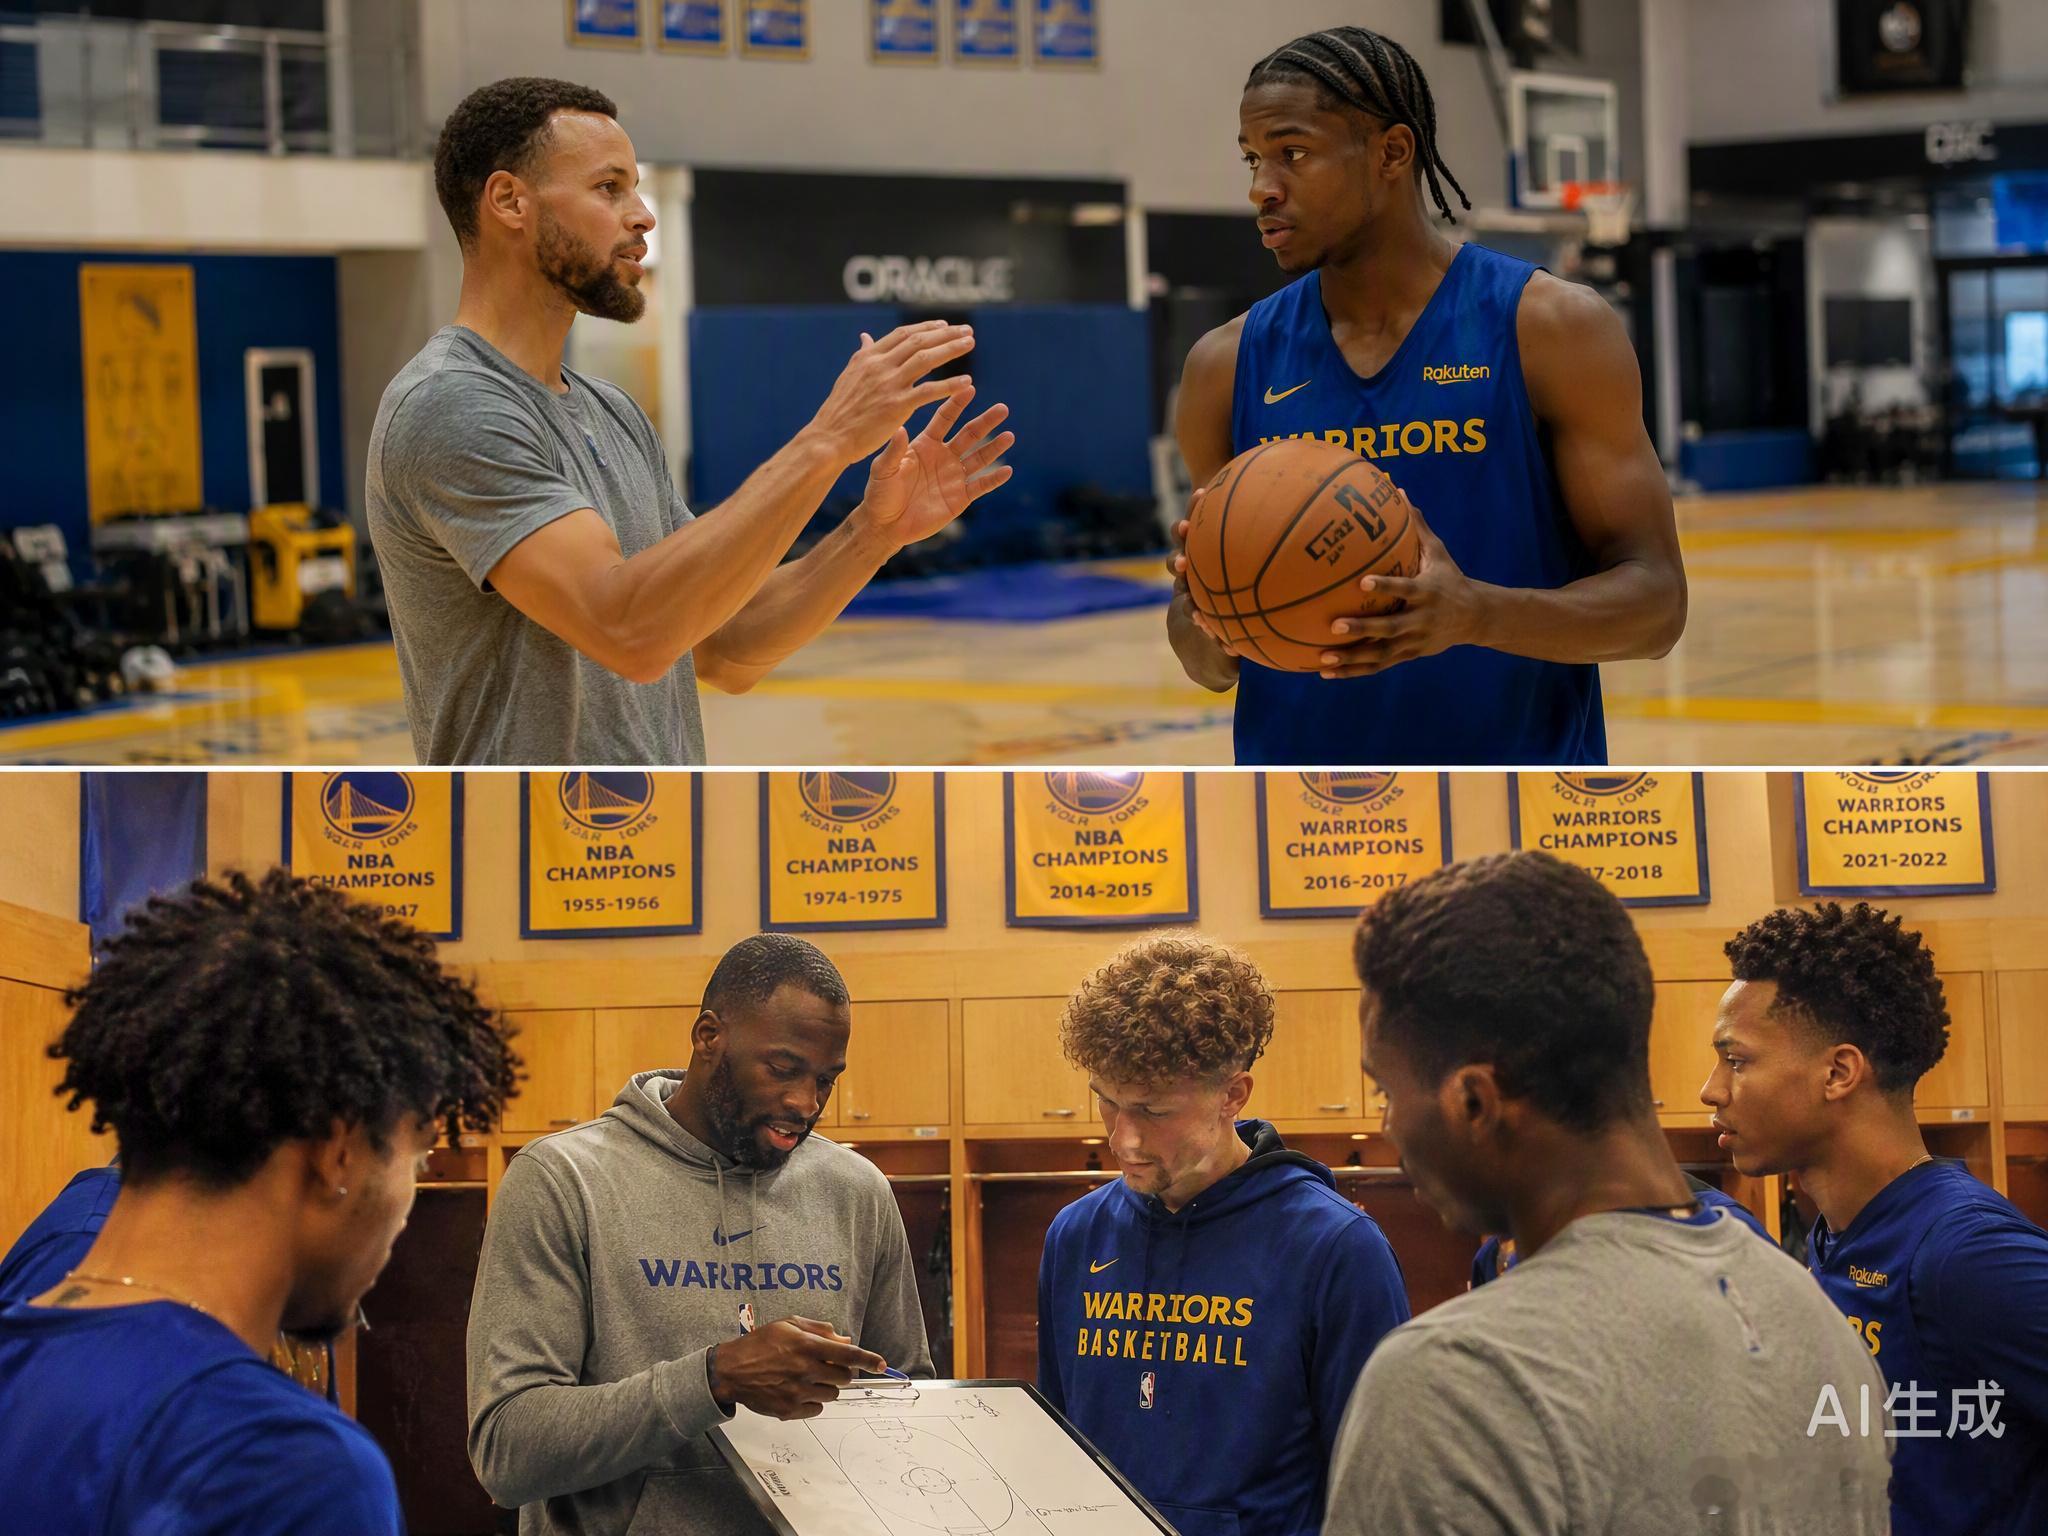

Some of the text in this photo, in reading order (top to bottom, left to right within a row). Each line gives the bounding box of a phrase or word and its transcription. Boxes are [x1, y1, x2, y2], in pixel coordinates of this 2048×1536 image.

[842, 255, 1014, 302] ORACLE
[1423, 364, 1490, 383] Rakuten
[1260, 418, 1487, 459] RRIORS
[1838, 796, 1946, 813] WARRIORS
[1300, 818, 1408, 836] WARRIORS
[1552, 809, 1662, 827] WARRIORS
[1824, 817, 1962, 835] CHAMPIONS
[828, 838, 876, 854] NBA
[1074, 830, 1124, 846] NBA
[1539, 830, 1678, 849] CHAMPIONS
[587, 845, 634, 861] NBA
[1286, 838, 1424, 858] CHAMPIONS
[347, 853, 394, 869] NBA
[786, 856, 919, 874] CHAMPIONS
[1033, 849, 1169, 867] CHAMPIONS
[1843, 852, 1948, 868] 2021-2022
[546, 864, 676, 881] CHAMPIONS
[1304, 873, 1407, 890] 2016-2017
[803, 889, 903, 905] 1974-1975
[1050, 883, 1153, 900] 2014-2015
[638, 1258, 843, 1292] WARRIORS
[1083, 1291, 1254, 1327] WARRIORS
[1077, 1328, 1248, 1366] BASKETBALL
